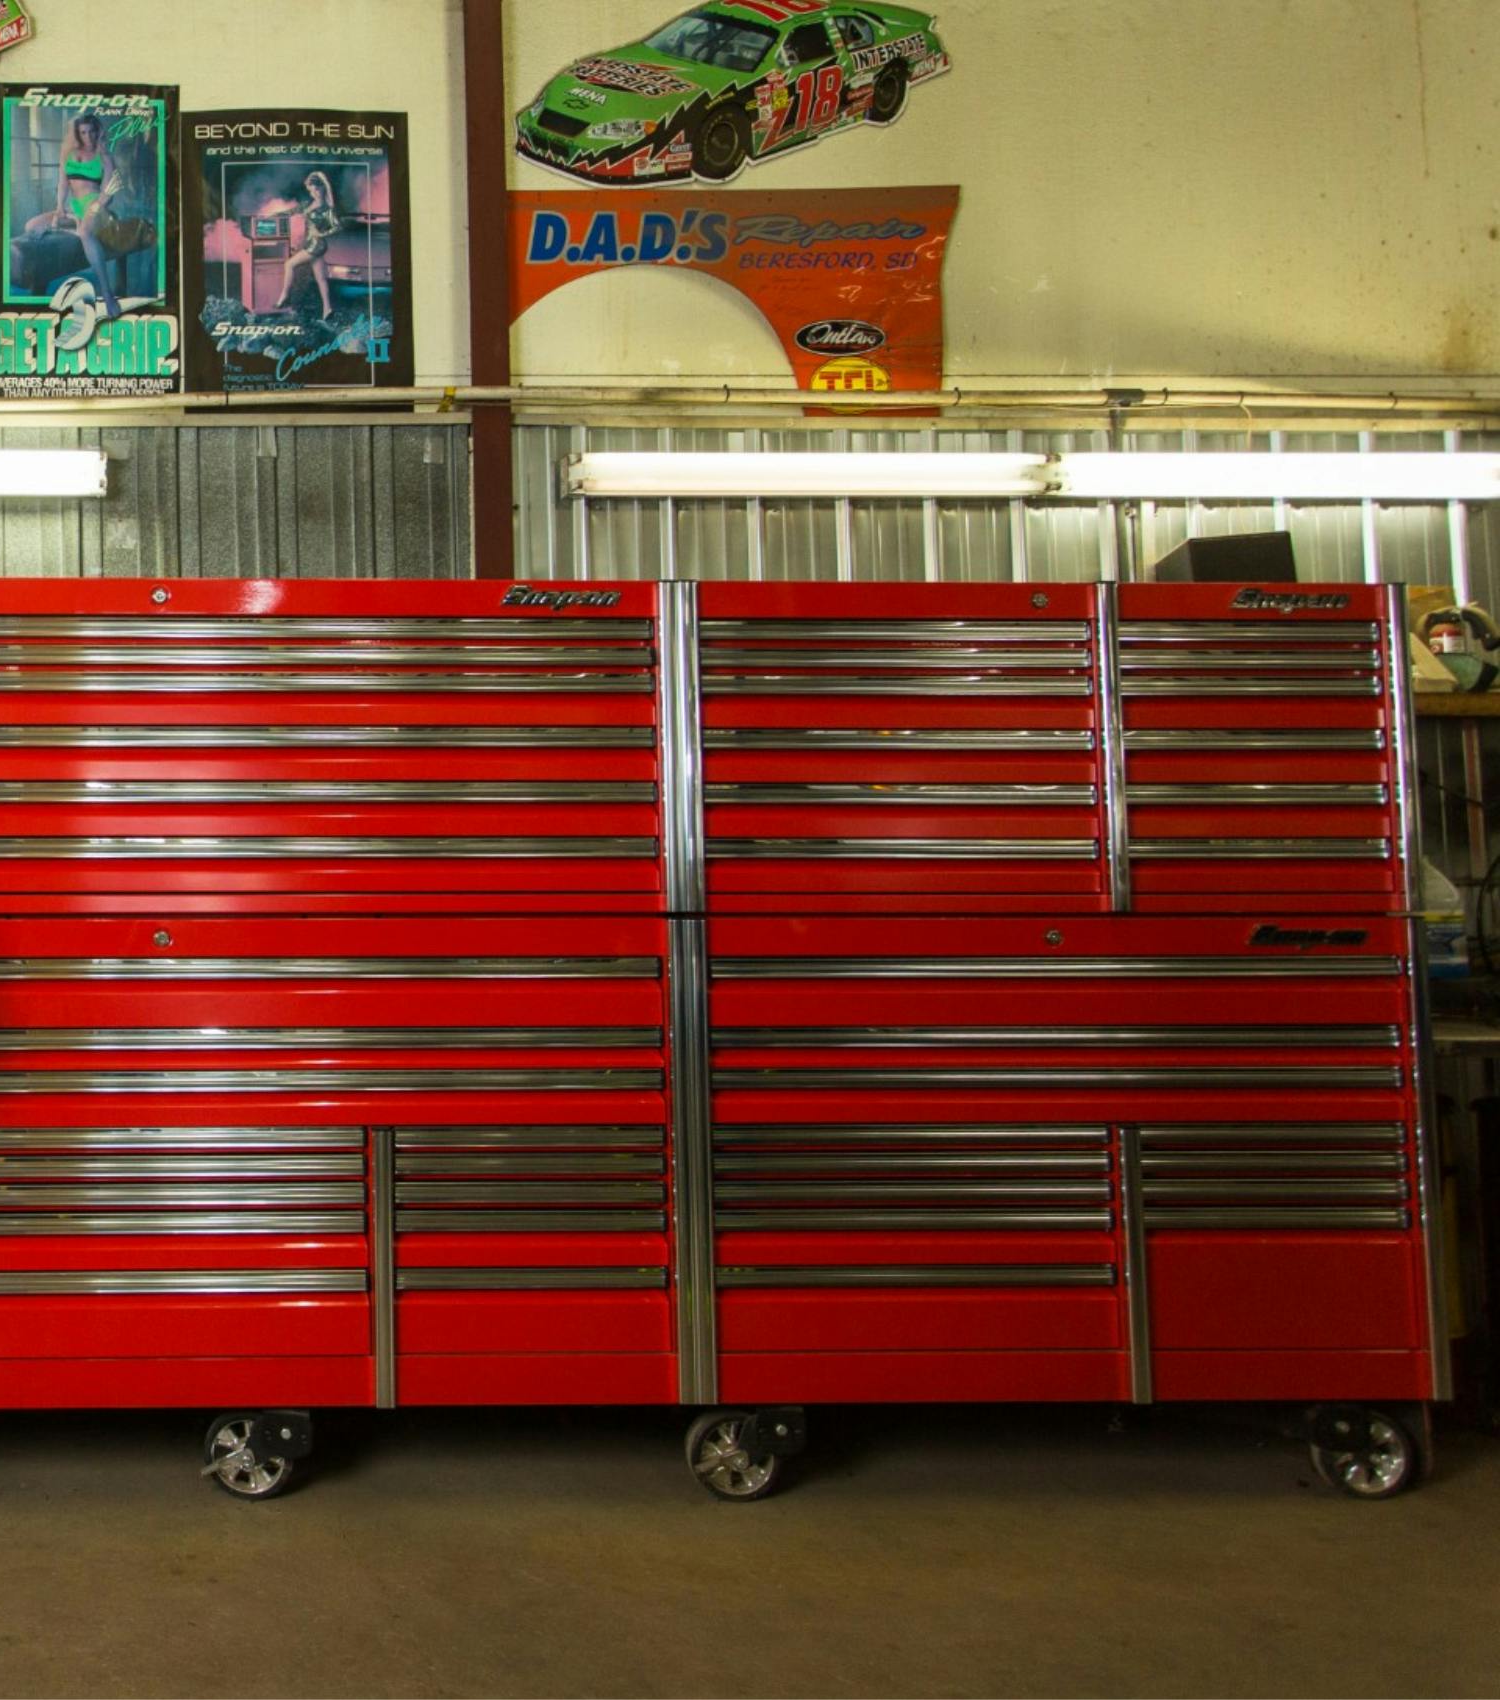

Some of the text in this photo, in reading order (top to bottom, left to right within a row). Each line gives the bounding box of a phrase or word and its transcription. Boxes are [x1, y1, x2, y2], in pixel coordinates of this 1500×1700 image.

[19, 88, 152, 113] Snap-on
[796, 65, 844, 132] 18
[194, 121, 396, 140] BEYOND THE SUN
[206, 143, 384, 155] and the rest of the universe
[733, 213, 927, 248] Repair
[885, 251, 918, 270] SD
[211, 321, 302, 339] Snap-on
[806, 324, 877, 345] Outlaw
[365, 338, 391, 363] II
[4, 388, 29, 398] THAN
[31, 388, 50, 397] ANY
[44, 378, 66, 389] 40%
[67, 379, 94, 389] MORE
[96, 379, 138, 389] TURNING
[139, 379, 173, 390] POWER
